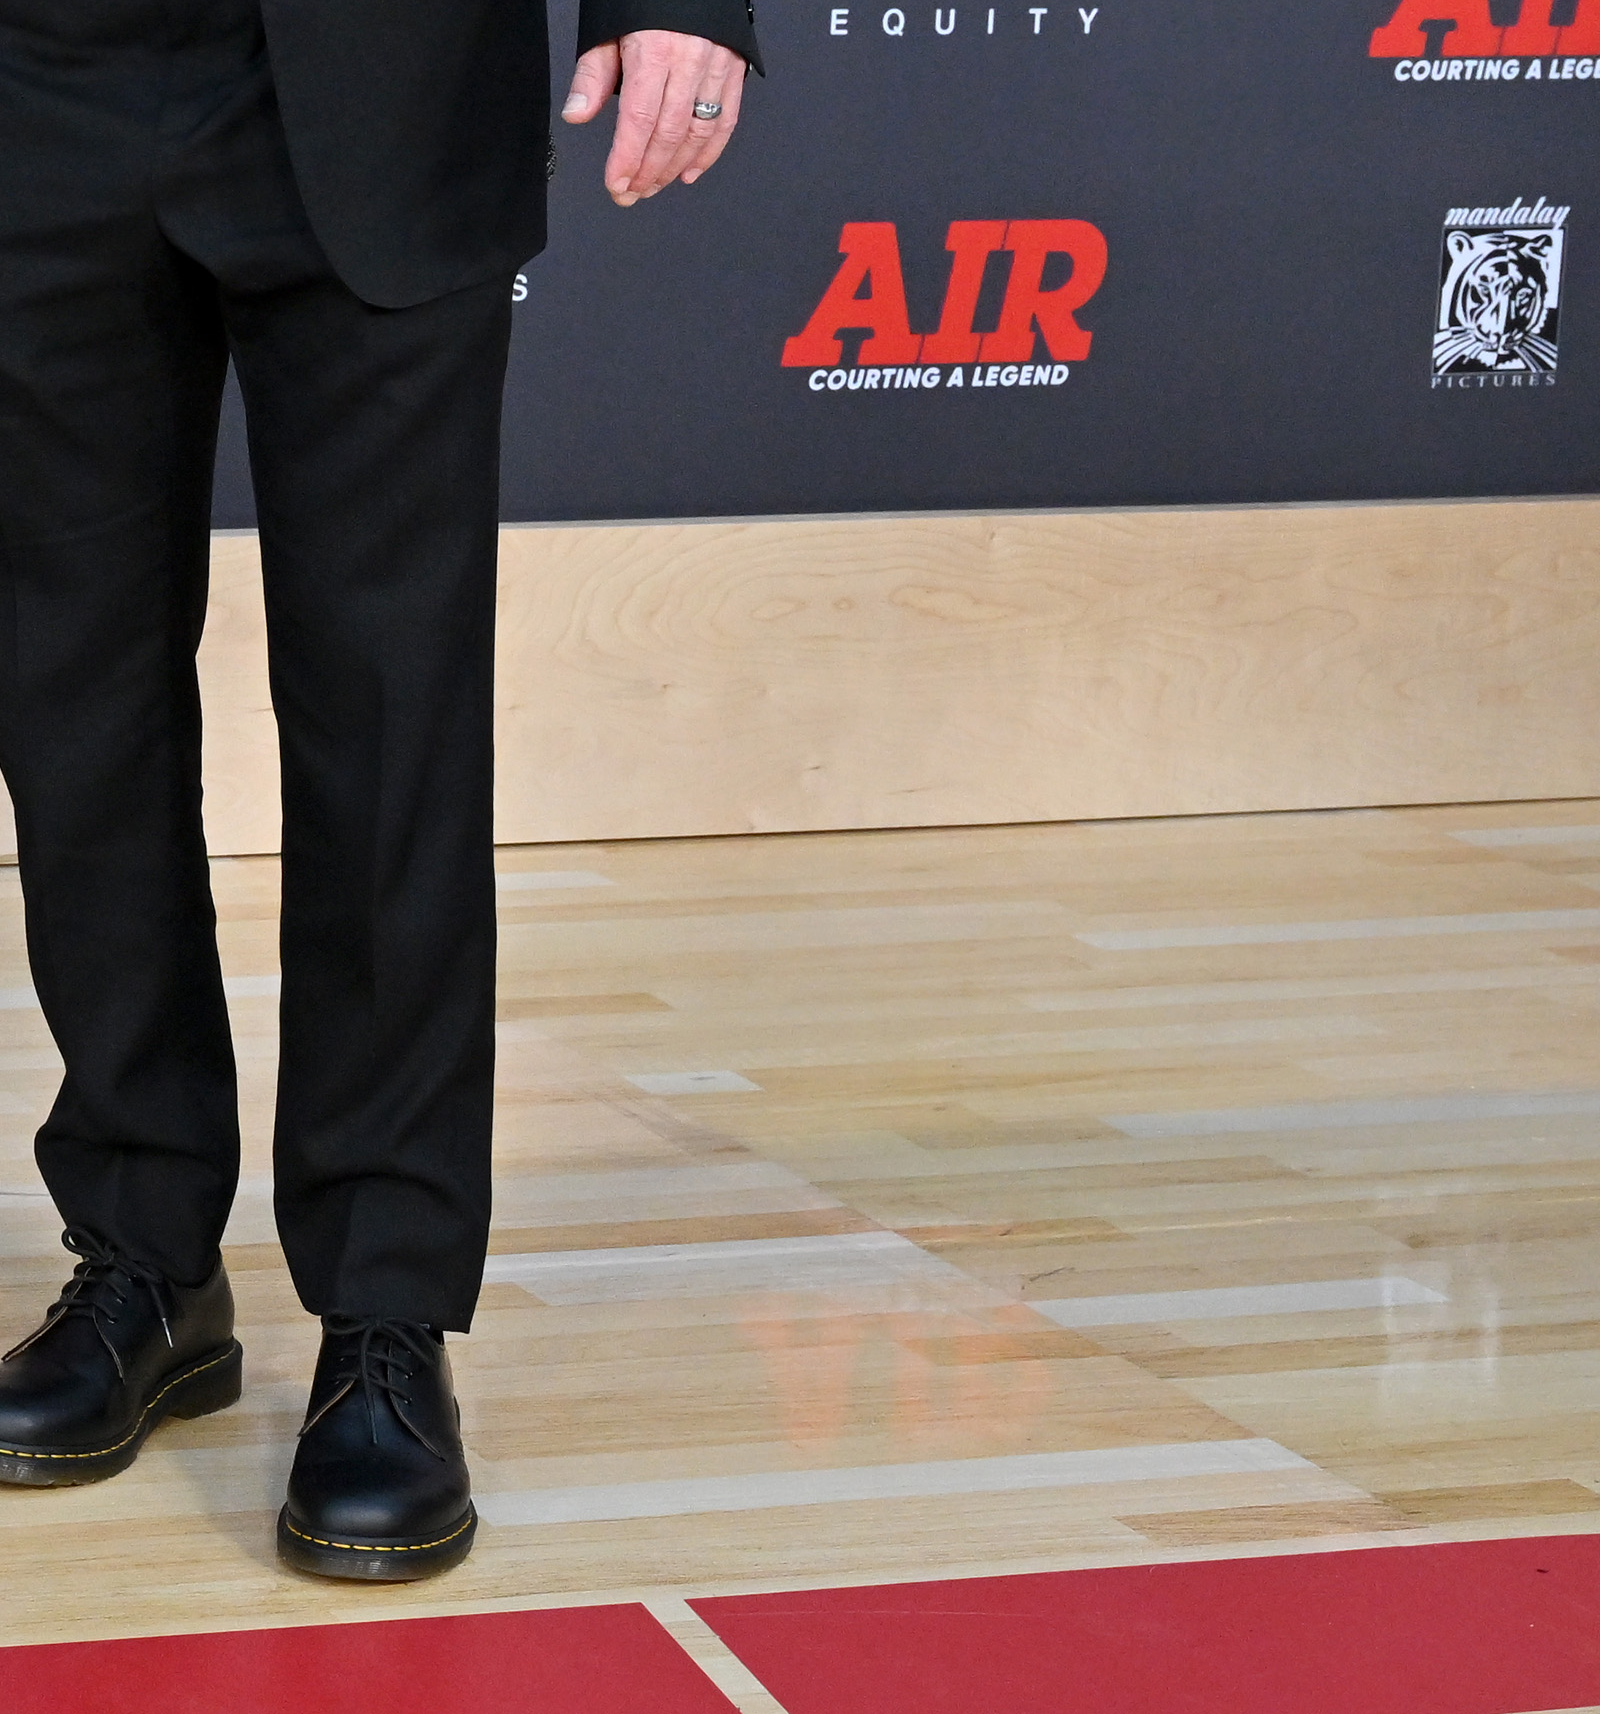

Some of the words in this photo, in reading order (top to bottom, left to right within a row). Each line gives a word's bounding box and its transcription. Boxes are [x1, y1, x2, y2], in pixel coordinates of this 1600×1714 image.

[830, 8, 1098, 36] EQUITY
[1395, 59, 1519, 81] COURTING
[1525, 59, 1541, 79] A
[1444, 196, 1570, 230] mandalay
[781, 219, 1107, 367] AIR
[809, 367, 940, 390] COURTING
[946, 367, 963, 387] A
[972, 365, 1069, 386] LEGEND
[1431, 374, 1557, 389] PICTURES
